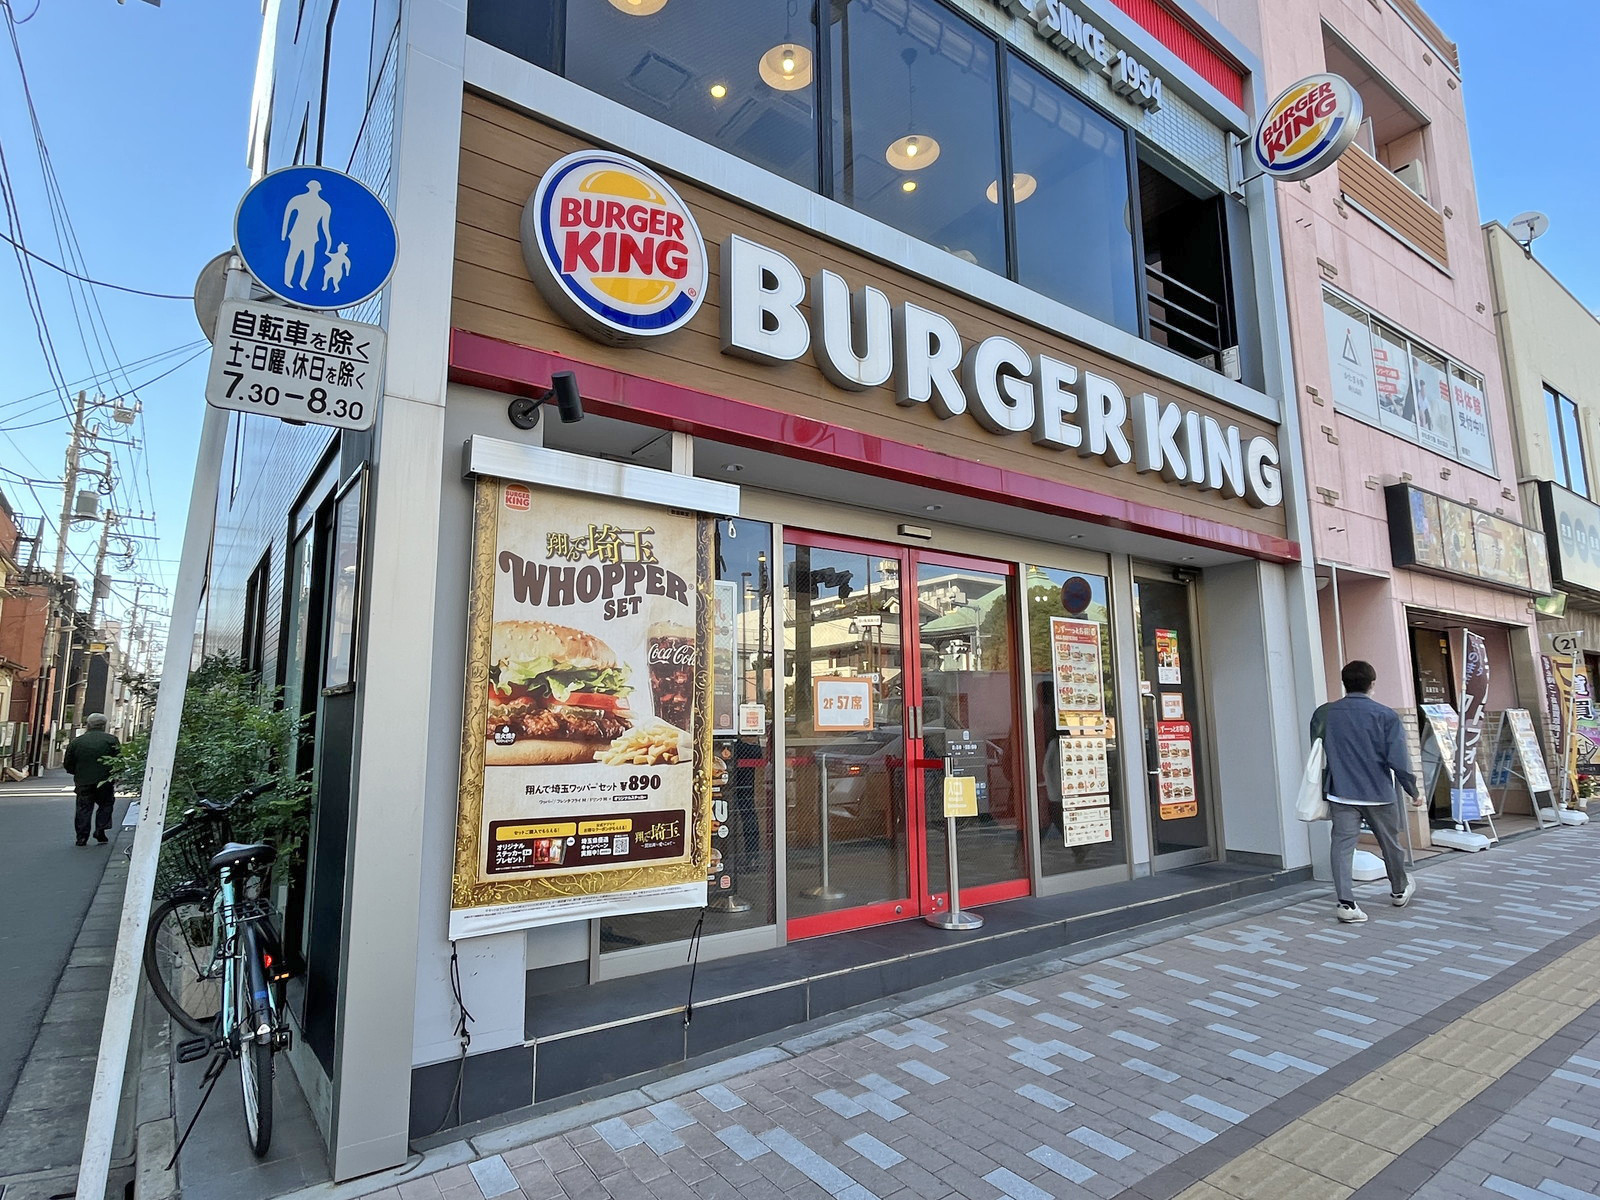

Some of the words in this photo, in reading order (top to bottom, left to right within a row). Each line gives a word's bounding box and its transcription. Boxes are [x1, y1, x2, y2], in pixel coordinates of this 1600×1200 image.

[1045, 0, 1108, 66] SINCE
[1116, 49, 1162, 110] 1954
[1263, 82, 1331, 146] BURGER
[1267, 93, 1336, 163] KING
[560, 197, 685, 240] BURGER
[561, 230, 689, 281] KING
[231, 310, 370, 360] 自転車を除く
[725, 234, 1132, 465] BURGER
[1136, 392, 1282, 507] KING
[505, 490, 530, 499] BURGER
[505, 496, 530, 507] KING
[546, 524, 658, 565] 翔んで埼玉
[499, 550, 689, 607] WHOPPER
[603, 596, 642, 621] SET
[1561, 638, 1577, 650] 21
[823, 698, 833, 710] 2F
[620, 774, 662, 791] ¥890
[635, 820, 680, 843] 翔んで埼玉
[495, 856, 526, 864] プレゼント!
[496, 850, 522, 858] ステッカー
